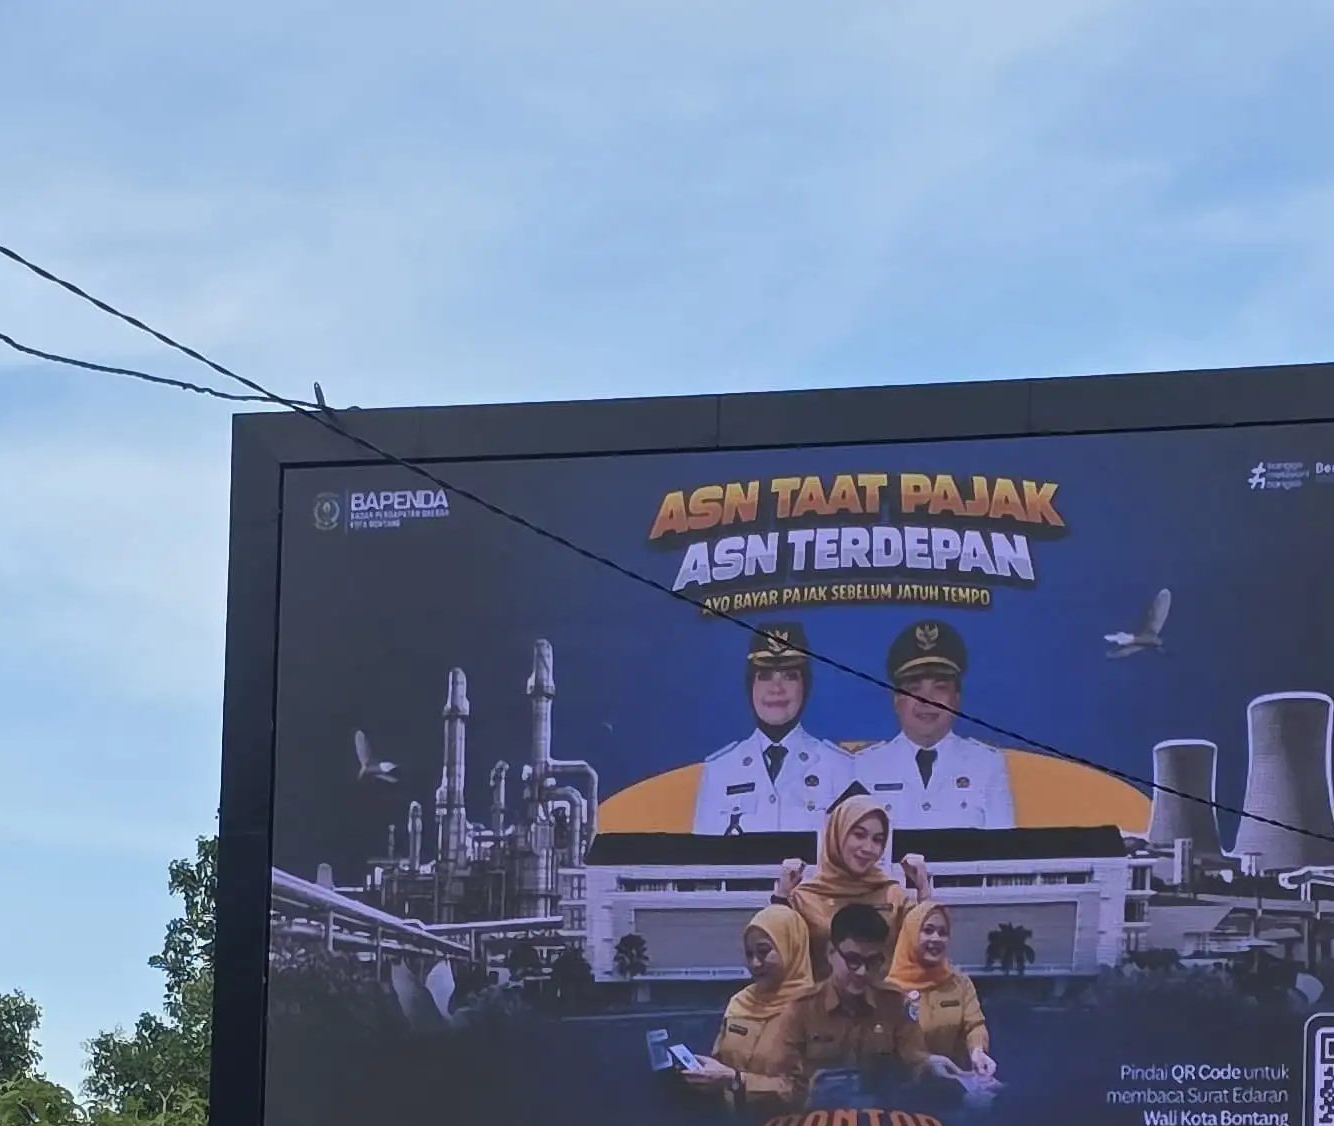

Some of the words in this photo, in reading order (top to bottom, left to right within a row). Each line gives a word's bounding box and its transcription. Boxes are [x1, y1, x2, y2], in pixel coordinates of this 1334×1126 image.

[351, 489, 448, 510] BAPENDA
[649, 481, 759, 541] ASN
[772, 474, 888, 519] TAAT
[900, 474, 1065, 526] PAJAK
[671, 532, 779, 591] ASN
[787, 527, 1035, 581] TERDEPAN
[702, 596, 730, 616] AYO
[733, 590, 778, 610] BAYAR
[783, 586, 827, 604] PAJAK
[831, 584, 891, 600] SEBELUM
[896, 585, 939, 600] JATUH
[942, 586, 990, 605] TEMPO
[1120, 1064, 1167, 1081] Pindai
[1171, 1064, 1195, 1083] QR
[1198, 1063, 1241, 1081] Code
[1243, 1063, 1289, 1080] untuk
[1106, 1088, 1184, 1104] membaca
[1188, 1087, 1228, 1103] Surat
[1232, 1086, 1289, 1103] Edaran
[1144, 1110, 1177, 1126] Wali
[1181, 1110, 1217, 1126] Kota
